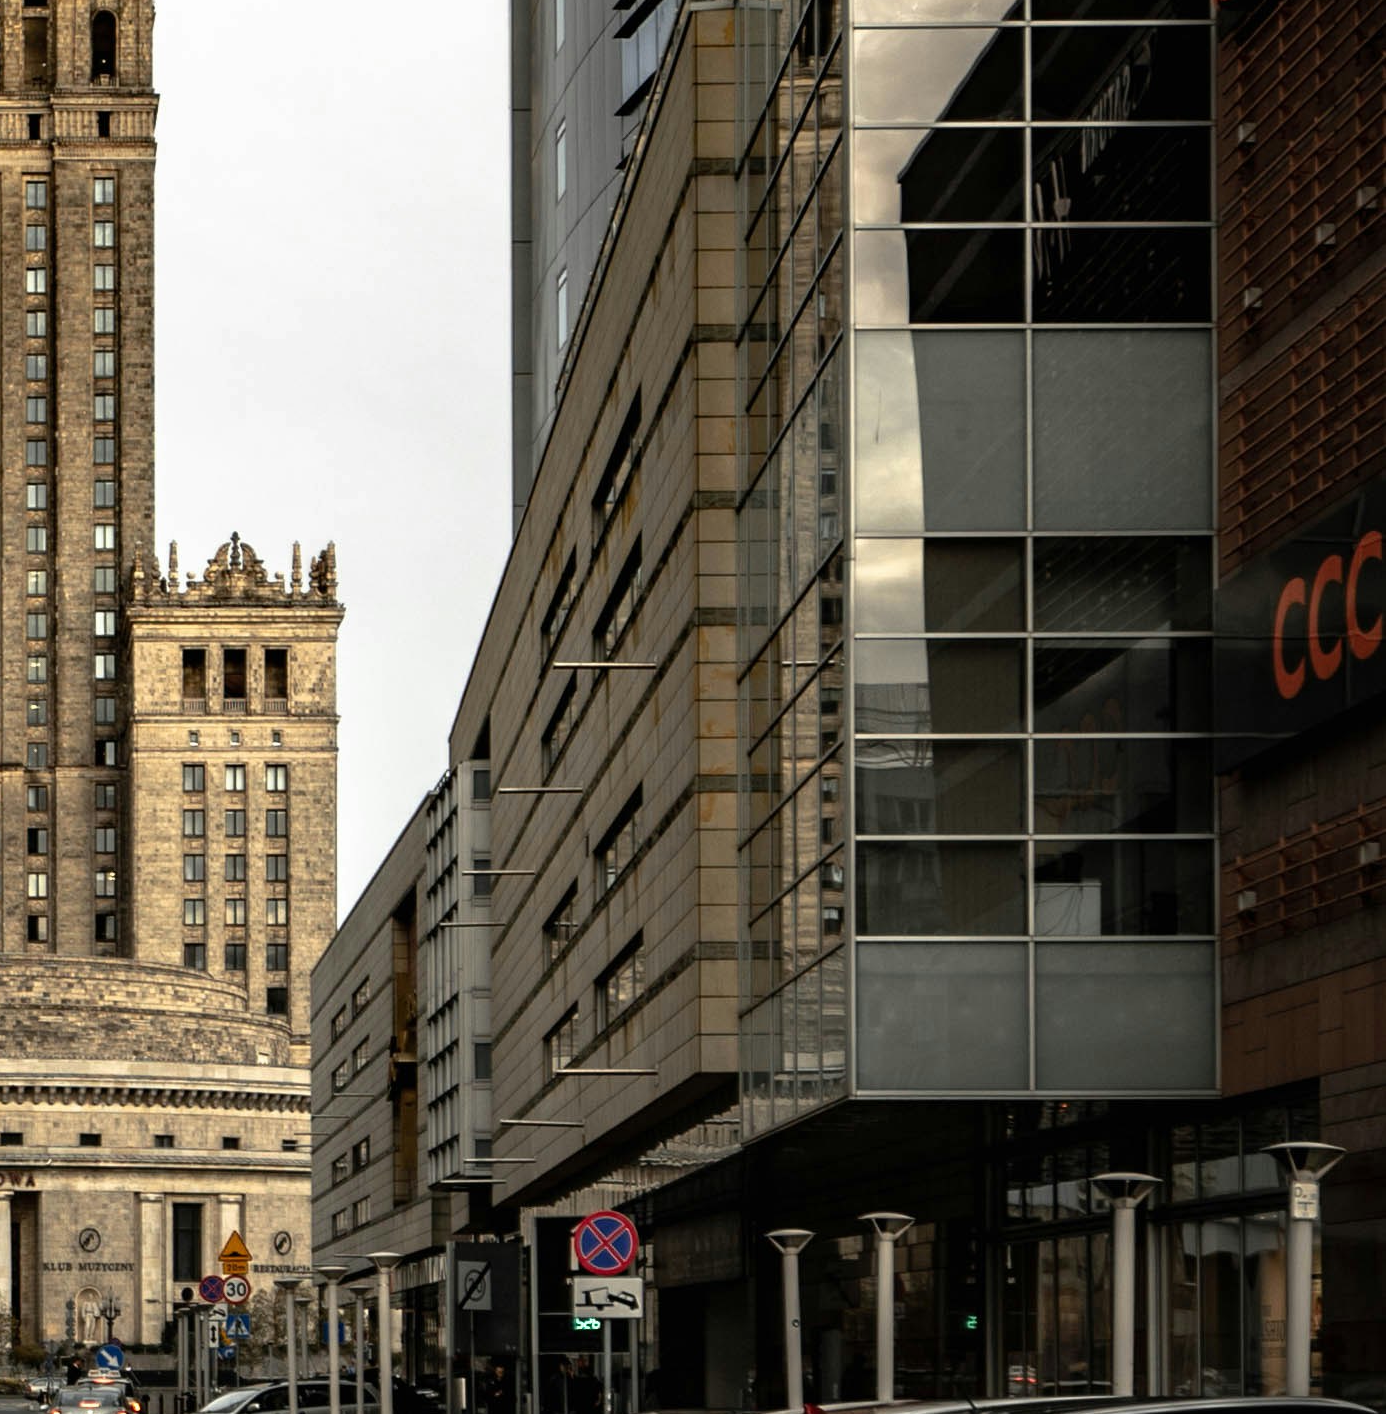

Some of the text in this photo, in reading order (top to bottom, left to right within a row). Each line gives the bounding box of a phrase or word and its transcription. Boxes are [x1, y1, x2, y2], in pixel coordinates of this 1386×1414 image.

[1271, 530, 1384, 700] CCC
[43, 1262, 134, 1272] KLUB MUZYCZNY
[226, 1282, 247, 1297] 30
